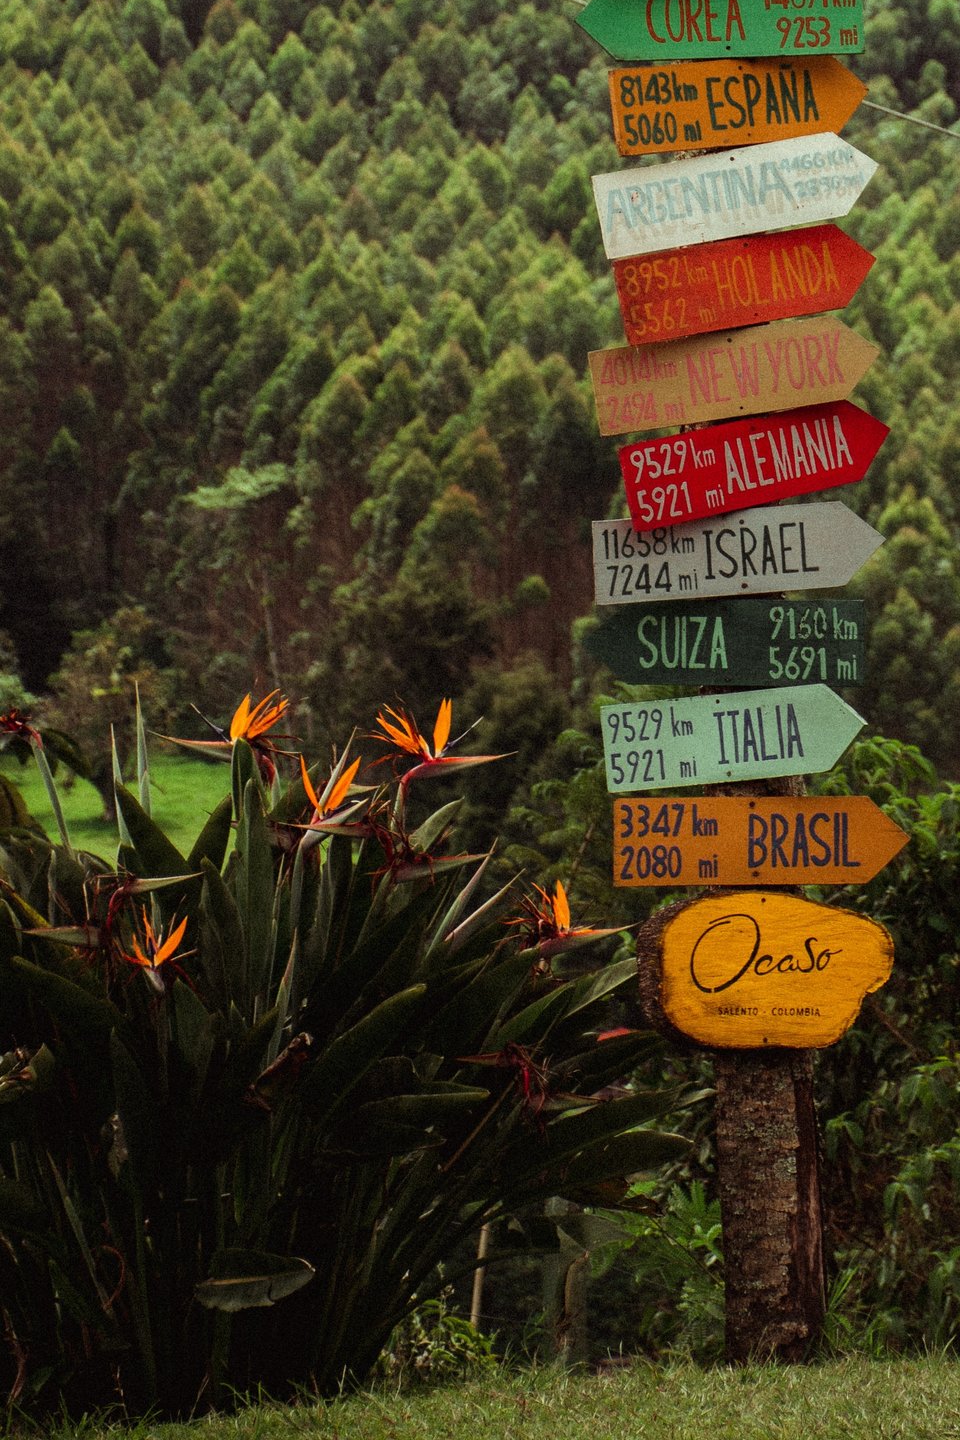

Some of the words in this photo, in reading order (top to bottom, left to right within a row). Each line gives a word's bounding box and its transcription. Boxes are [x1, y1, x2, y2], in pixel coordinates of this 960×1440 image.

[776, 17, 830, 49] 9253
[839, 24, 858, 46] mi
[620, 72, 672, 107] 8143
[672, 72, 698, 102] km
[705, 63, 820, 131] ESPAÑA
[623, 112, 677, 147] 5060
[606, 160, 800, 234] ARGENTINA
[623, 261, 682, 297] 8952
[683, 255, 710, 286] km
[712, 241, 840, 311] HOLANDA
[629, 298, 689, 337] 5562
[699, 304, 717, 324] mi
[685, 348, 761, 407] NEW
[762, 330, 845, 394] YORK
[607, 391, 657, 429] 2494
[664, 395, 685, 420] mi
[629, 441, 687, 484] 9529
[691, 438, 716, 469] km
[724, 415, 854, 495] ALEMANIA
[637, 482, 692, 523] 5921
[705, 484, 725, 510] mi
[601, 528, 667, 560] 11658
[670, 527, 695, 554] km
[702, 522, 820, 580] ISRAEL
[607, 562, 672, 598] 7244
[679, 569, 698, 592] mi
[637, 616, 729, 669] SUIZA
[832, 607, 858, 640] km
[769, 646, 827, 680] 5691
[837, 655, 857, 681] mi
[607, 709, 663, 744] 9529
[671, 707, 693, 737] km
[713, 703, 804, 765] ITALIA
[610, 750, 664, 785] 5921
[680, 756, 696, 778] mi
[620, 804, 685, 838] 3347
[692, 803, 718, 837] km
[748, 811, 861, 869] BRASIL
[620, 845, 682, 880] 2080
[699, 855, 718, 879] mi
[718, 1007, 759, 1016] SALENTO
[771, 1007, 821, 1017] COLOMBIA
